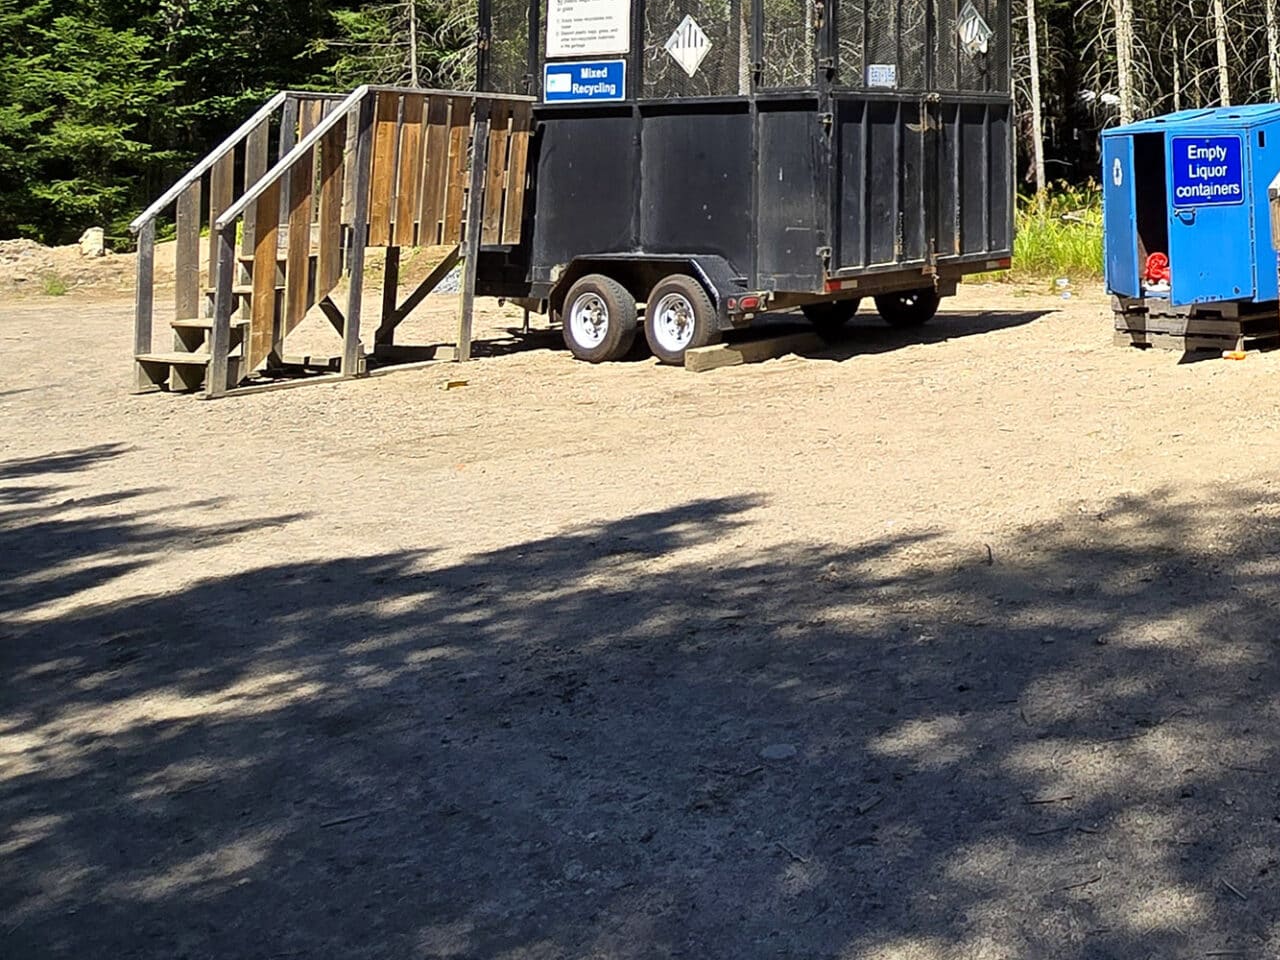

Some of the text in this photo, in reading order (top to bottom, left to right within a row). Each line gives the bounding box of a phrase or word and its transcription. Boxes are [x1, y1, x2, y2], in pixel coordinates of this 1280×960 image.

[581, 67, 607, 79] Mixed
[572, 82, 616, 96] Recycling
[1187, 144, 1227, 161] Empty
[1188, 163, 1228, 181] Liquor
[1176, 182, 1240, 198] containers
